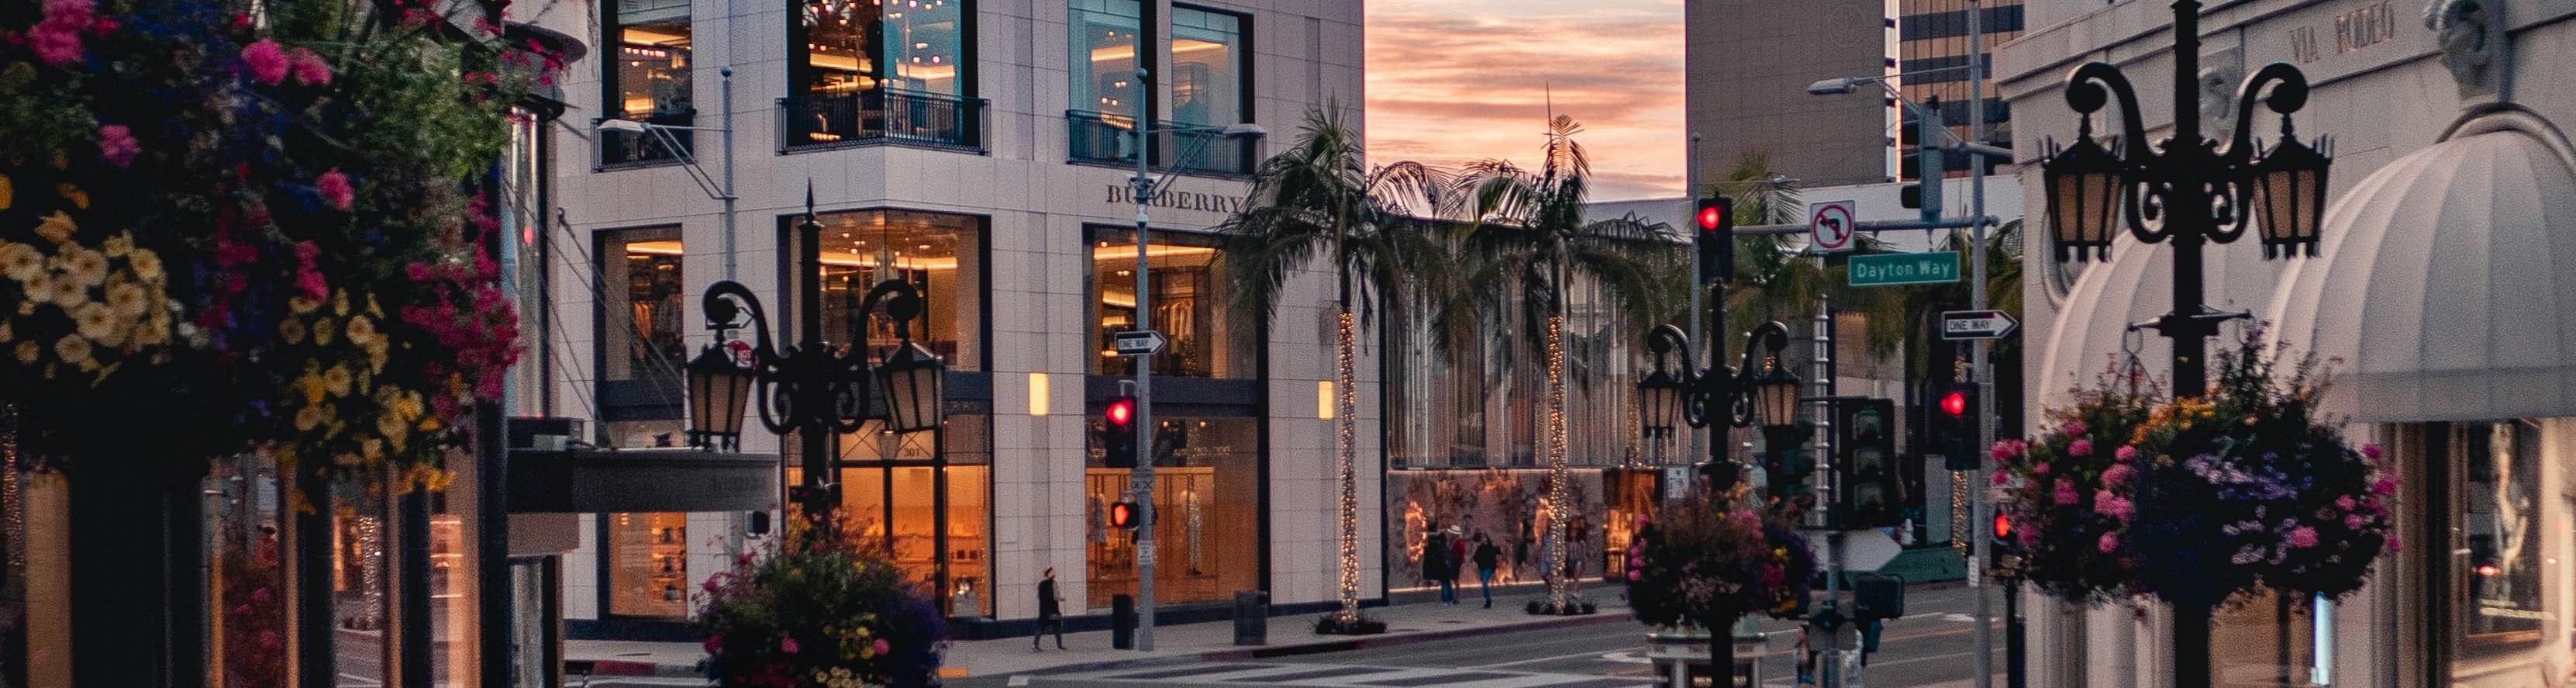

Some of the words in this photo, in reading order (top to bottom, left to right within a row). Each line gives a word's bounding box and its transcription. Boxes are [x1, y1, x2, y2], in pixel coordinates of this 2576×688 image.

[2289, 26, 2319, 63] VIA
[2336, 1, 2394, 54] RODEO
[1857, 262, 1913, 279] Dayton
[1919, 260, 1950, 278] Way
[1950, 320, 1967, 330] ONE
[1971, 319, 1990, 329] WAY
[1135, 339, 1149, 347] WAY
